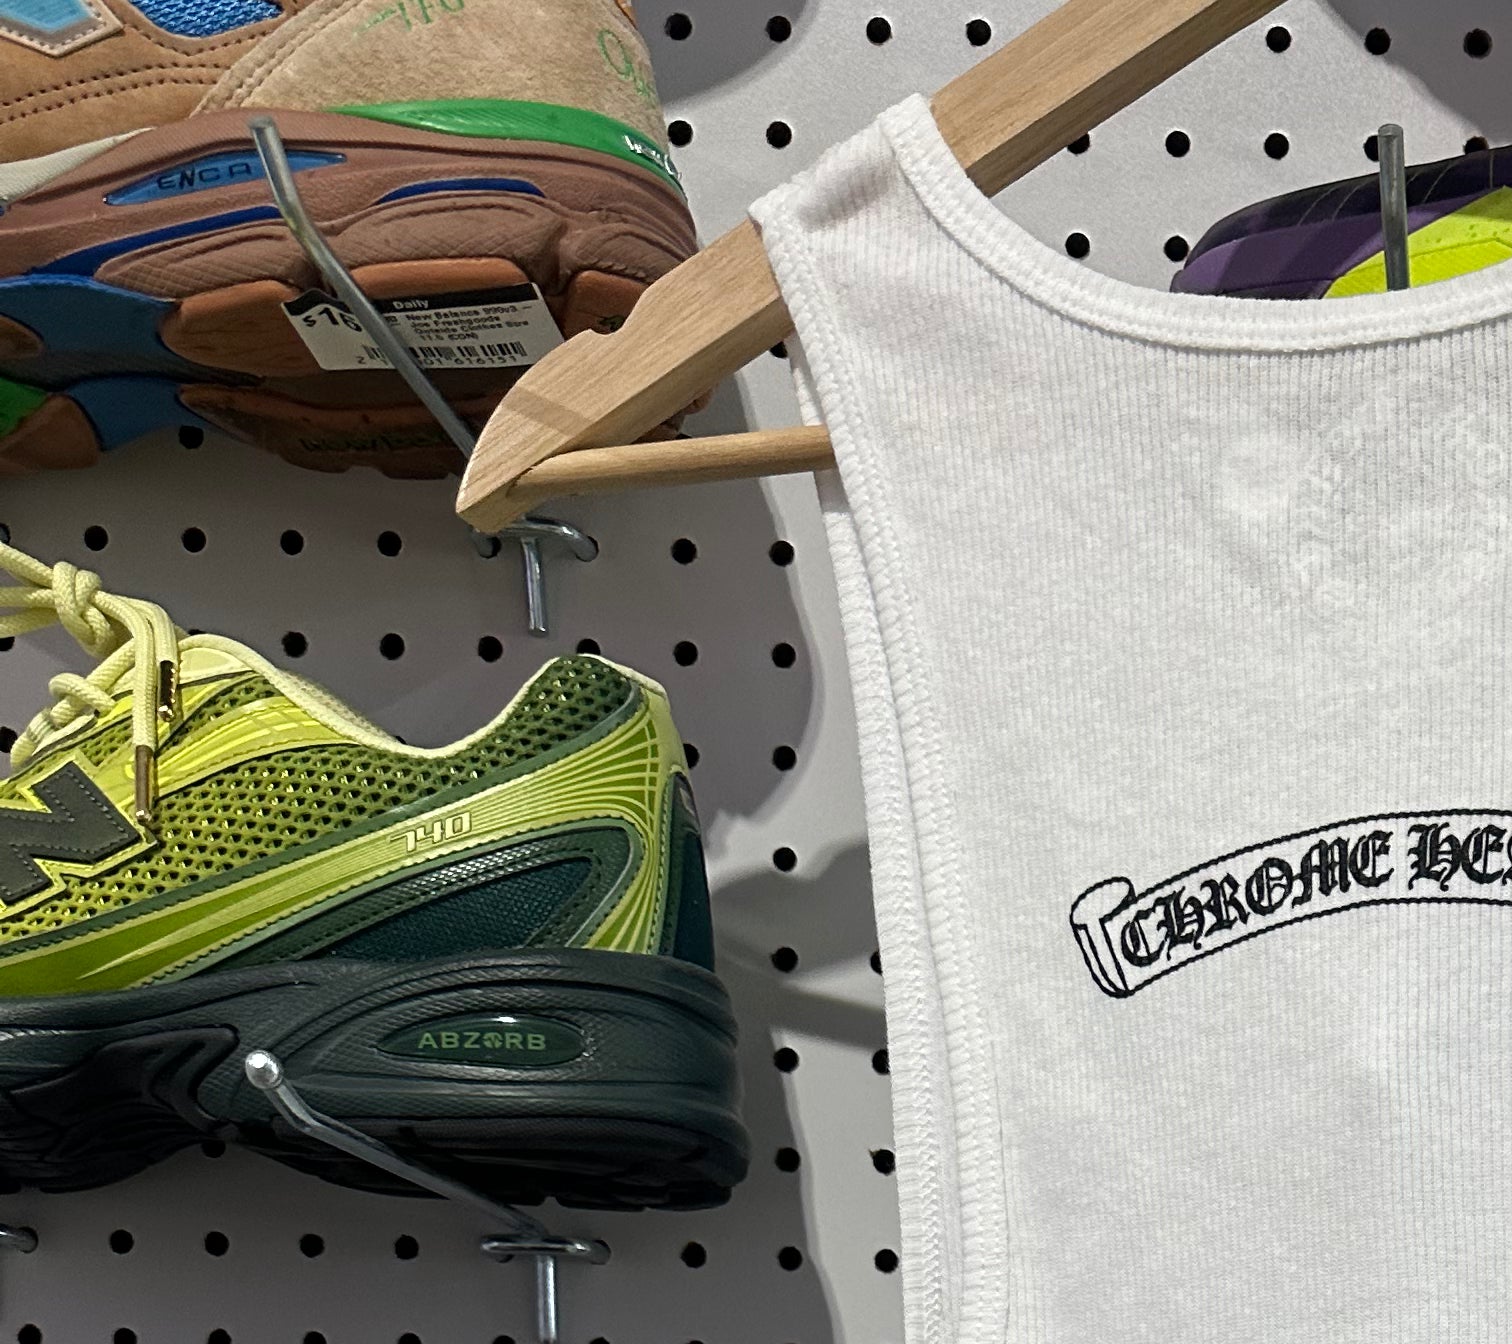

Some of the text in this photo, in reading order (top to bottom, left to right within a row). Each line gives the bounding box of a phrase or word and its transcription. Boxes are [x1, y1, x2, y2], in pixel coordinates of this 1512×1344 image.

[156, 163, 252, 191] ENCA
[393, 299, 429, 310] Daily
[405, 312, 432, 321] New
[434, 305, 480, 320] Balance
[482, 304, 518, 316] 990v3
[410, 320, 431, 328] Joe
[433, 315, 501, 327] Freshgoods
[1120, 830, 1395, 967] CHROME
[418, 1031, 547, 1051] ABZORB
